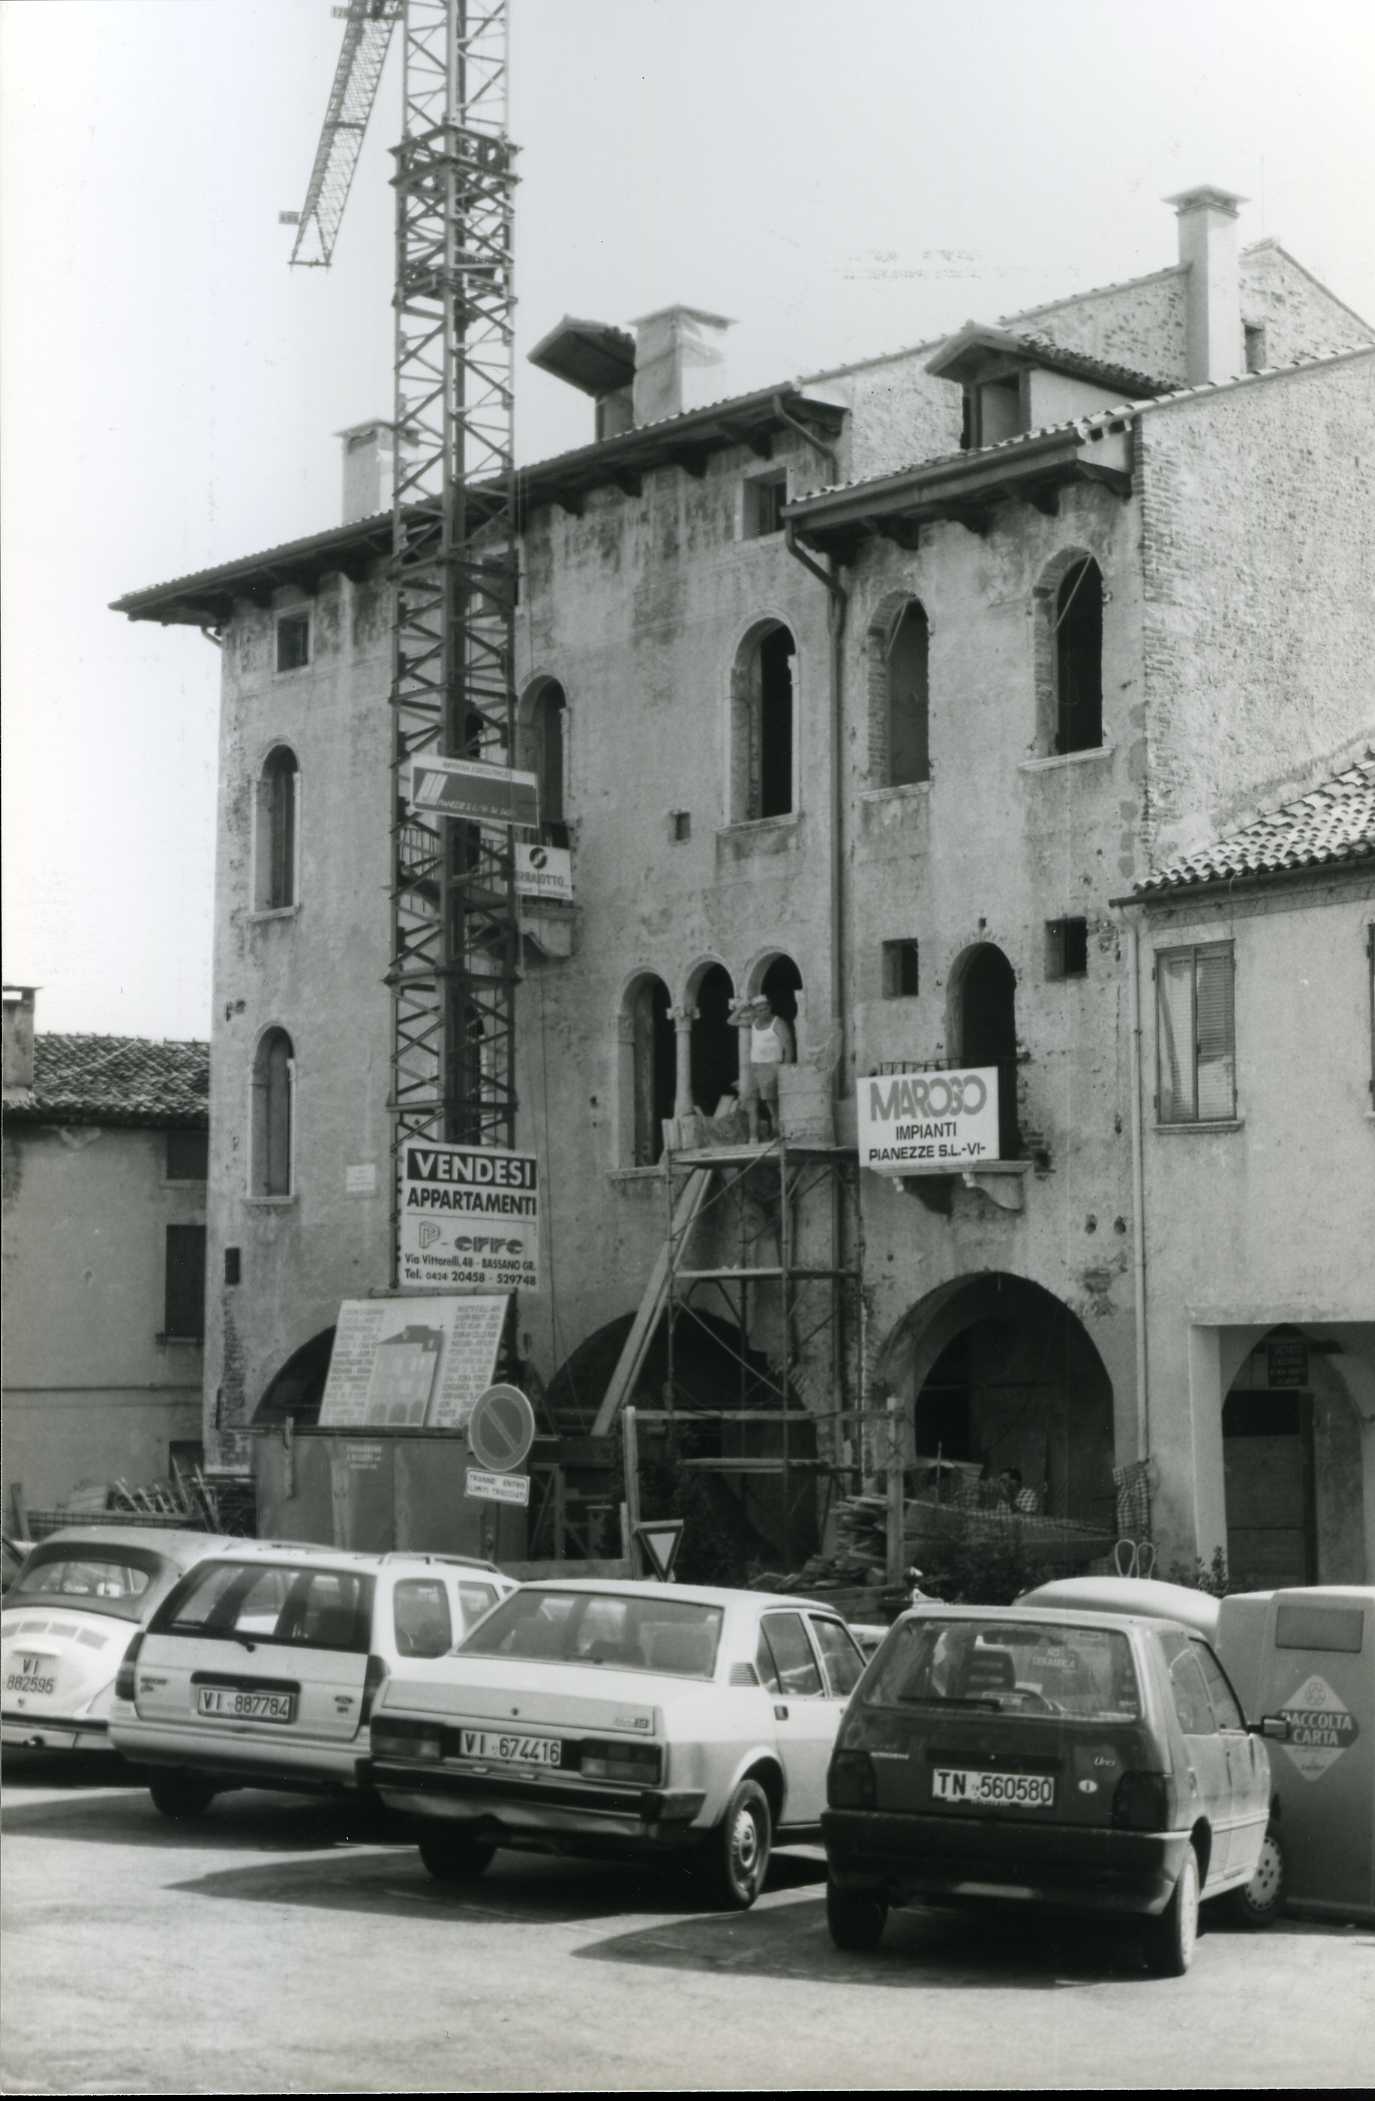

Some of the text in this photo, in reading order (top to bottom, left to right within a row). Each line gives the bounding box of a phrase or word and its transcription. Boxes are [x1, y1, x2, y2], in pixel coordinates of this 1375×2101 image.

[869, 1074, 988, 1122] MAROSO
[896, 1121, 957, 1141] IMPIANTI
[869, 1145, 935, 1162] PIANEZZE
[414, 1152, 531, 1187] VENDESI
[406, 1187, 537, 1216] APPARTAMENTI
[404, 1253, 420, 1265] Via
[481, 1258, 520, 1271] BASSANO
[404, 1268, 422, 1280] Tel.
[425, 1271, 447, 1281] 0424
[451, 1271, 485, 1283] 20458
[496, 1272, 537, 1286] 529748
[23, 1658, 40, 1675] VI
[203, 1691, 289, 1717] VI 887784
[464, 1733, 561, 1763] VI 674416
[1292, 1728, 1340, 1746] CARTA
[937, 1771, 1053, 1802] TN 560580
